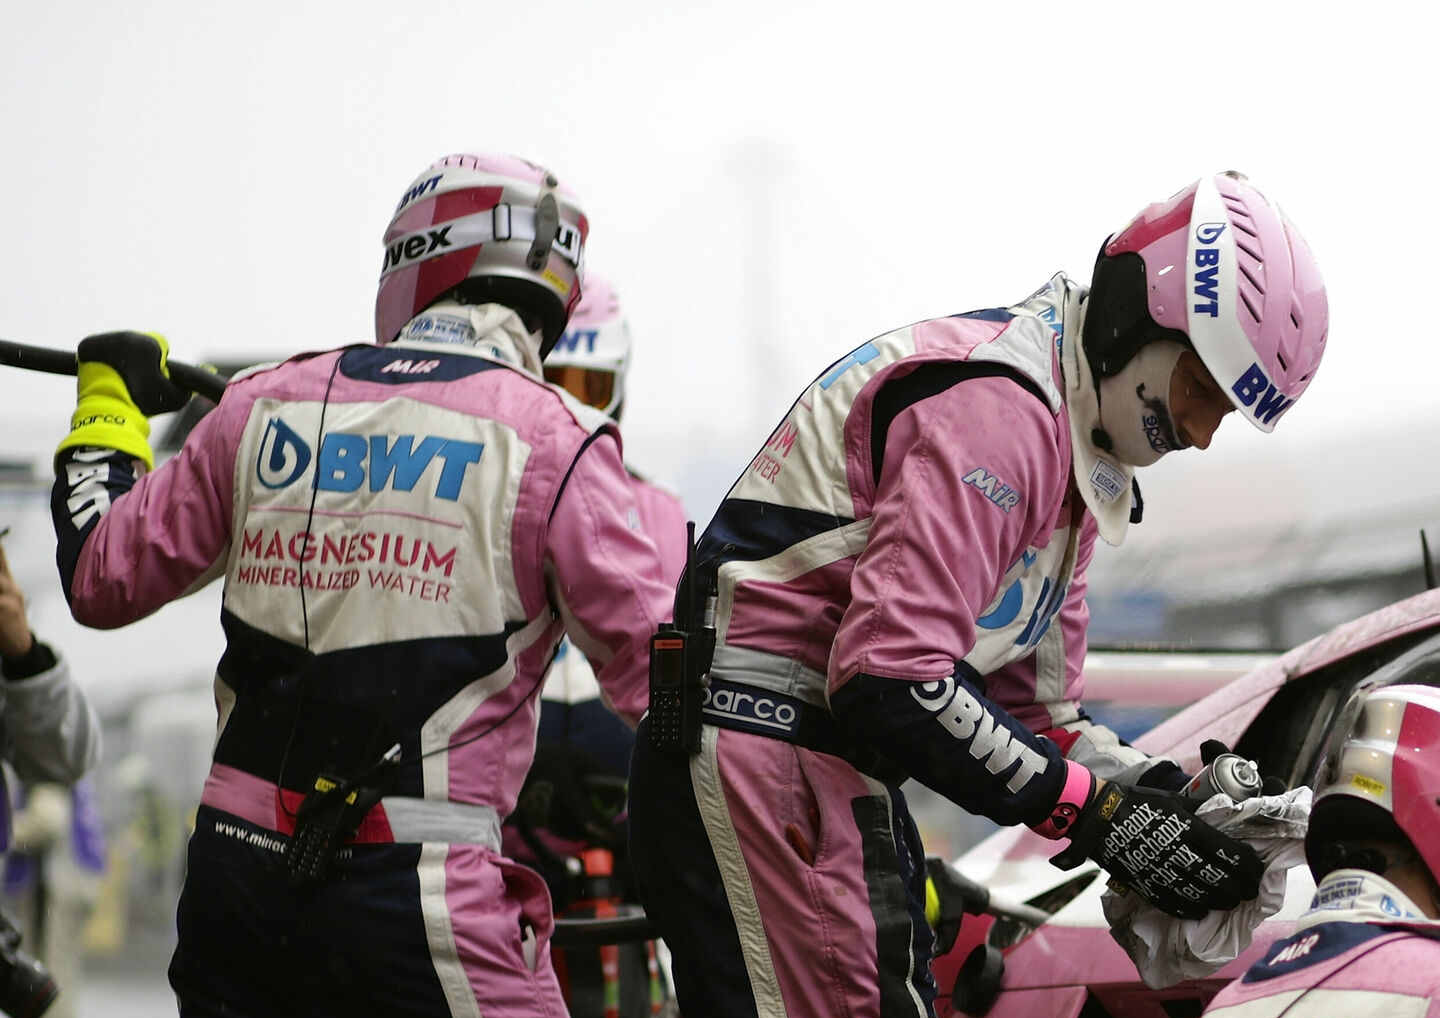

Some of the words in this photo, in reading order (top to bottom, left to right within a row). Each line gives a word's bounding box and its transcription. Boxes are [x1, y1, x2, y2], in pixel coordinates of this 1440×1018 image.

[398, 173, 444, 209] BWT
[1194, 248, 1220, 318] BWT
[312, 432, 485, 502] BWT
[241, 528, 458, 577] MAGNESIUM
[237, 566, 360, 590] MINERALIZED
[368, 569, 451, 603] WATER
[936, 685, 1049, 795] BWT
[1117, 813, 1188, 876] Mechanix
